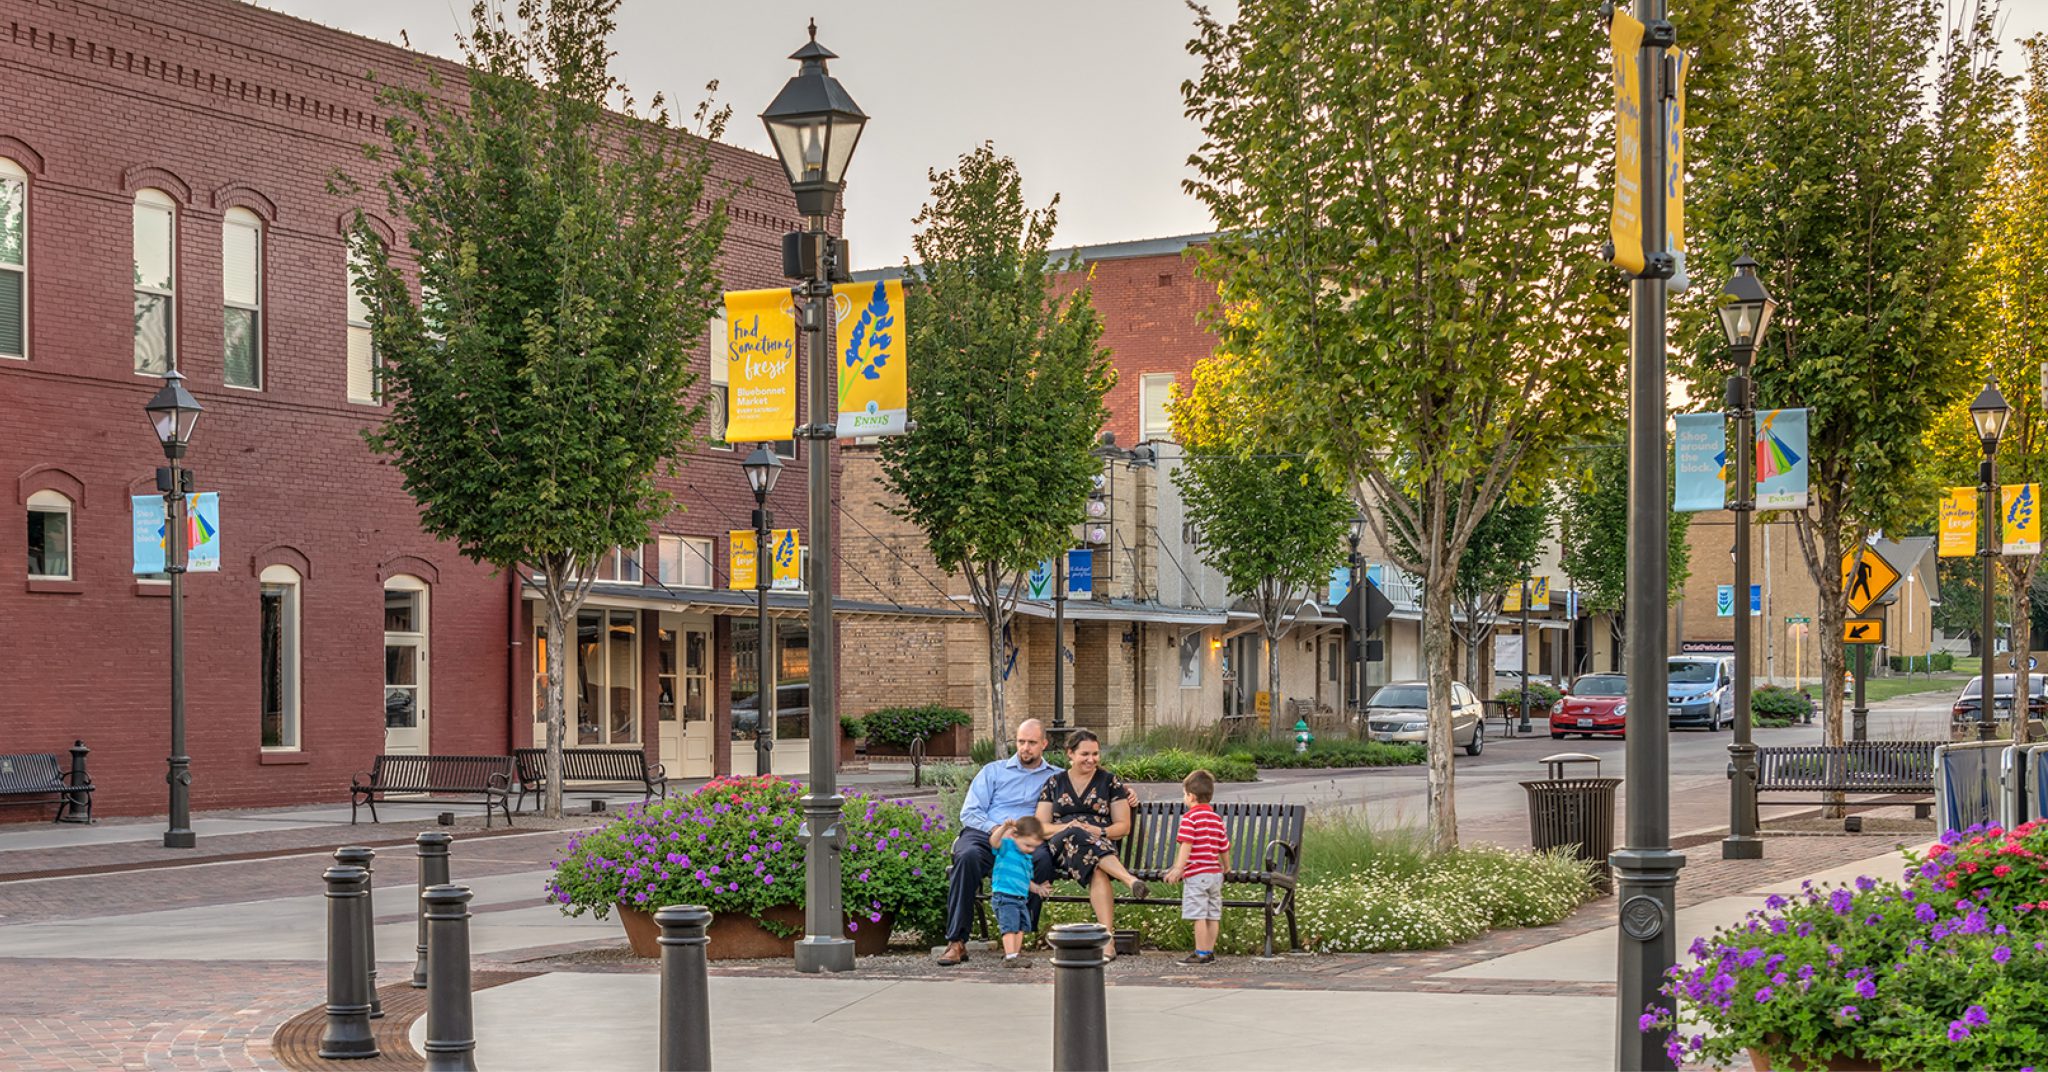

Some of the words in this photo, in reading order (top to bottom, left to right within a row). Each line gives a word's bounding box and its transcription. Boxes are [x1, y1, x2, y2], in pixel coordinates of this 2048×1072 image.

[734, 314, 759, 340] Find
[744, 354, 790, 381] fresh
[737, 386, 786, 397] Bluebonnet
[736, 396, 768, 406] Market
[854, 415, 889, 427] ENNIS
[1680, 432, 1708, 442] Shop
[1680, 441, 1718, 450] around
[1680, 453, 1698, 462] the
[1680, 463, 1713, 473] block.
